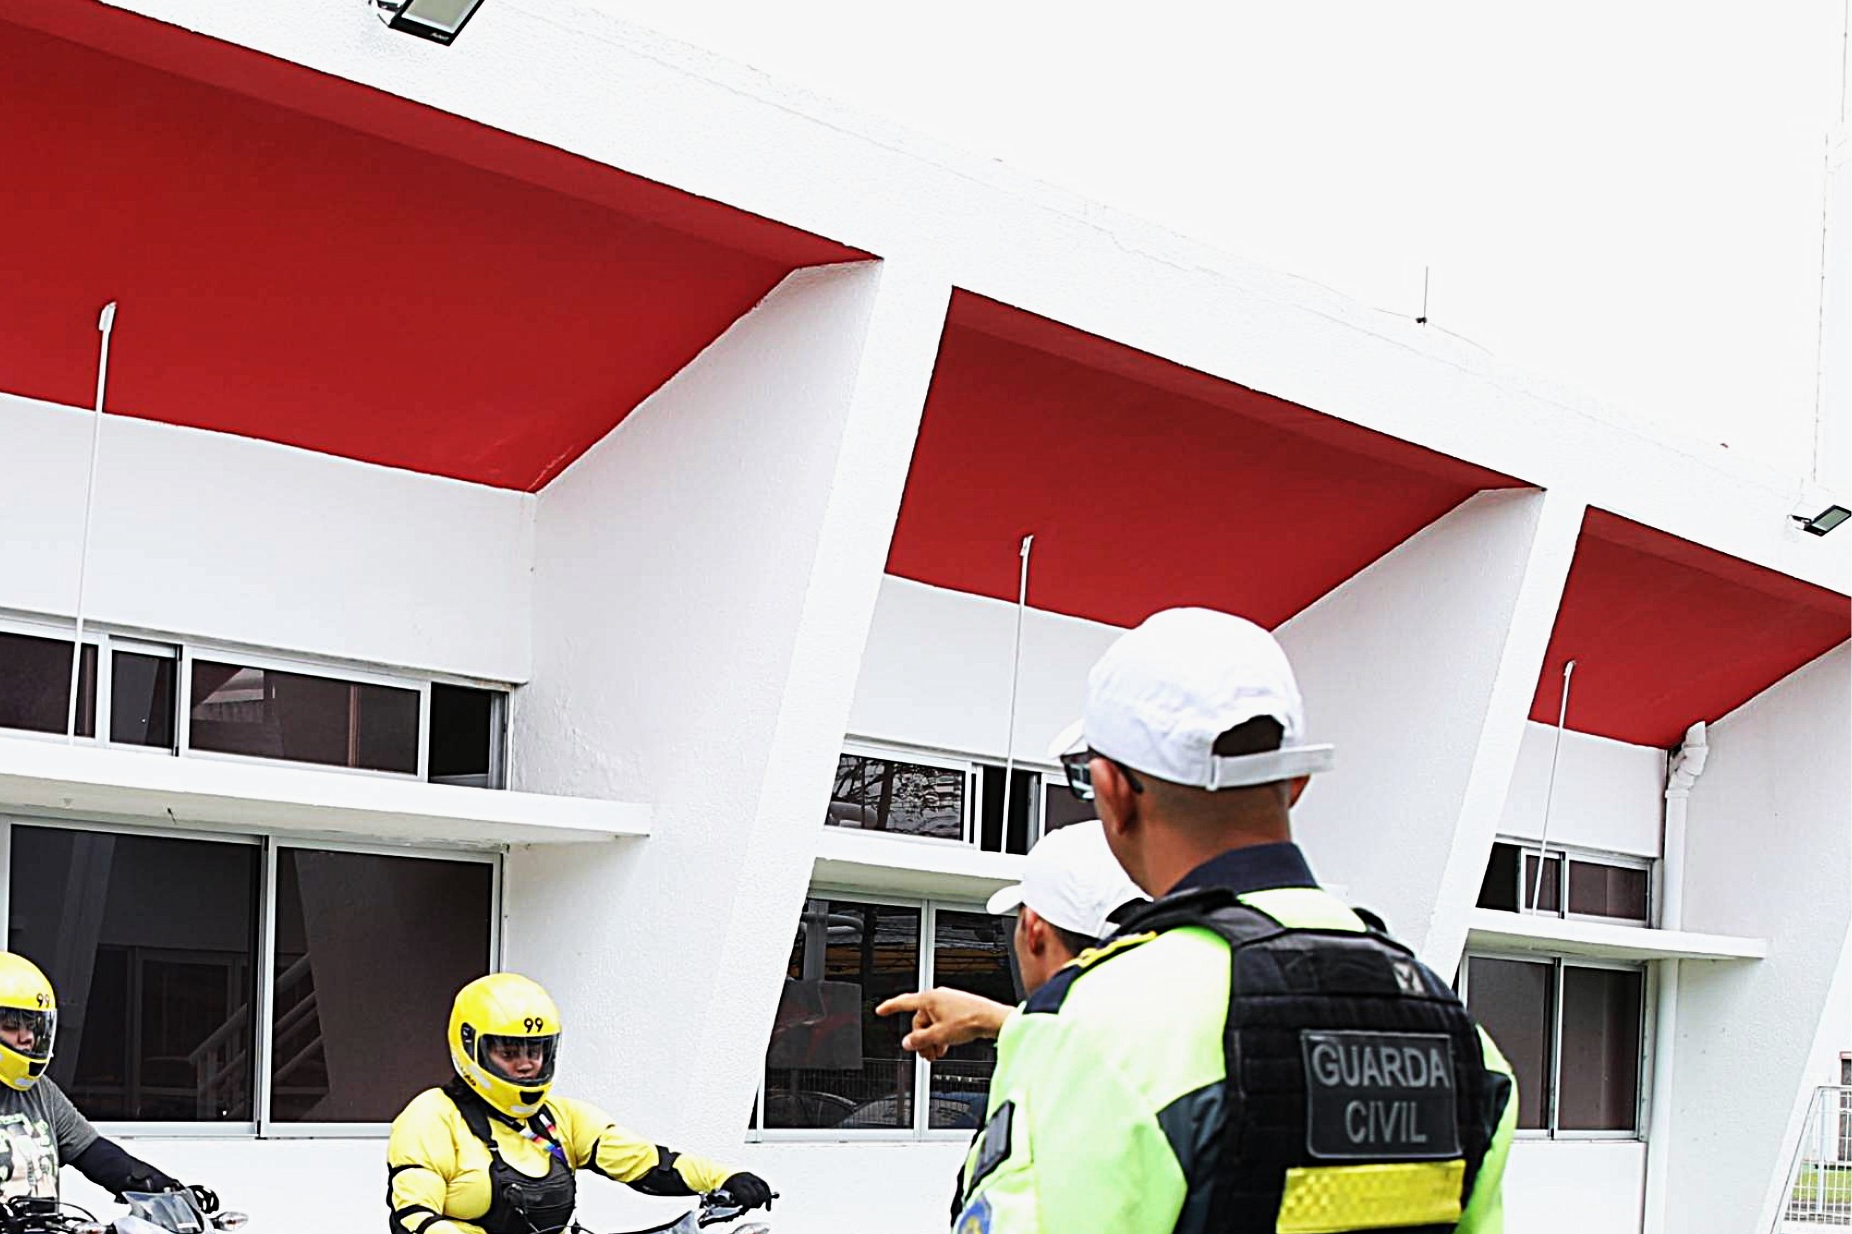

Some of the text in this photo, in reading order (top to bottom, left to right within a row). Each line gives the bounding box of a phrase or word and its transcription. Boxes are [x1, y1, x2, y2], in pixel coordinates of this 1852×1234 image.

[36, 993, 50, 1008] 99
[524, 1017, 544, 1033] 99
[1312, 1044, 1450, 1087] GUARDA
[1345, 1100, 1427, 1143] CIVIL
